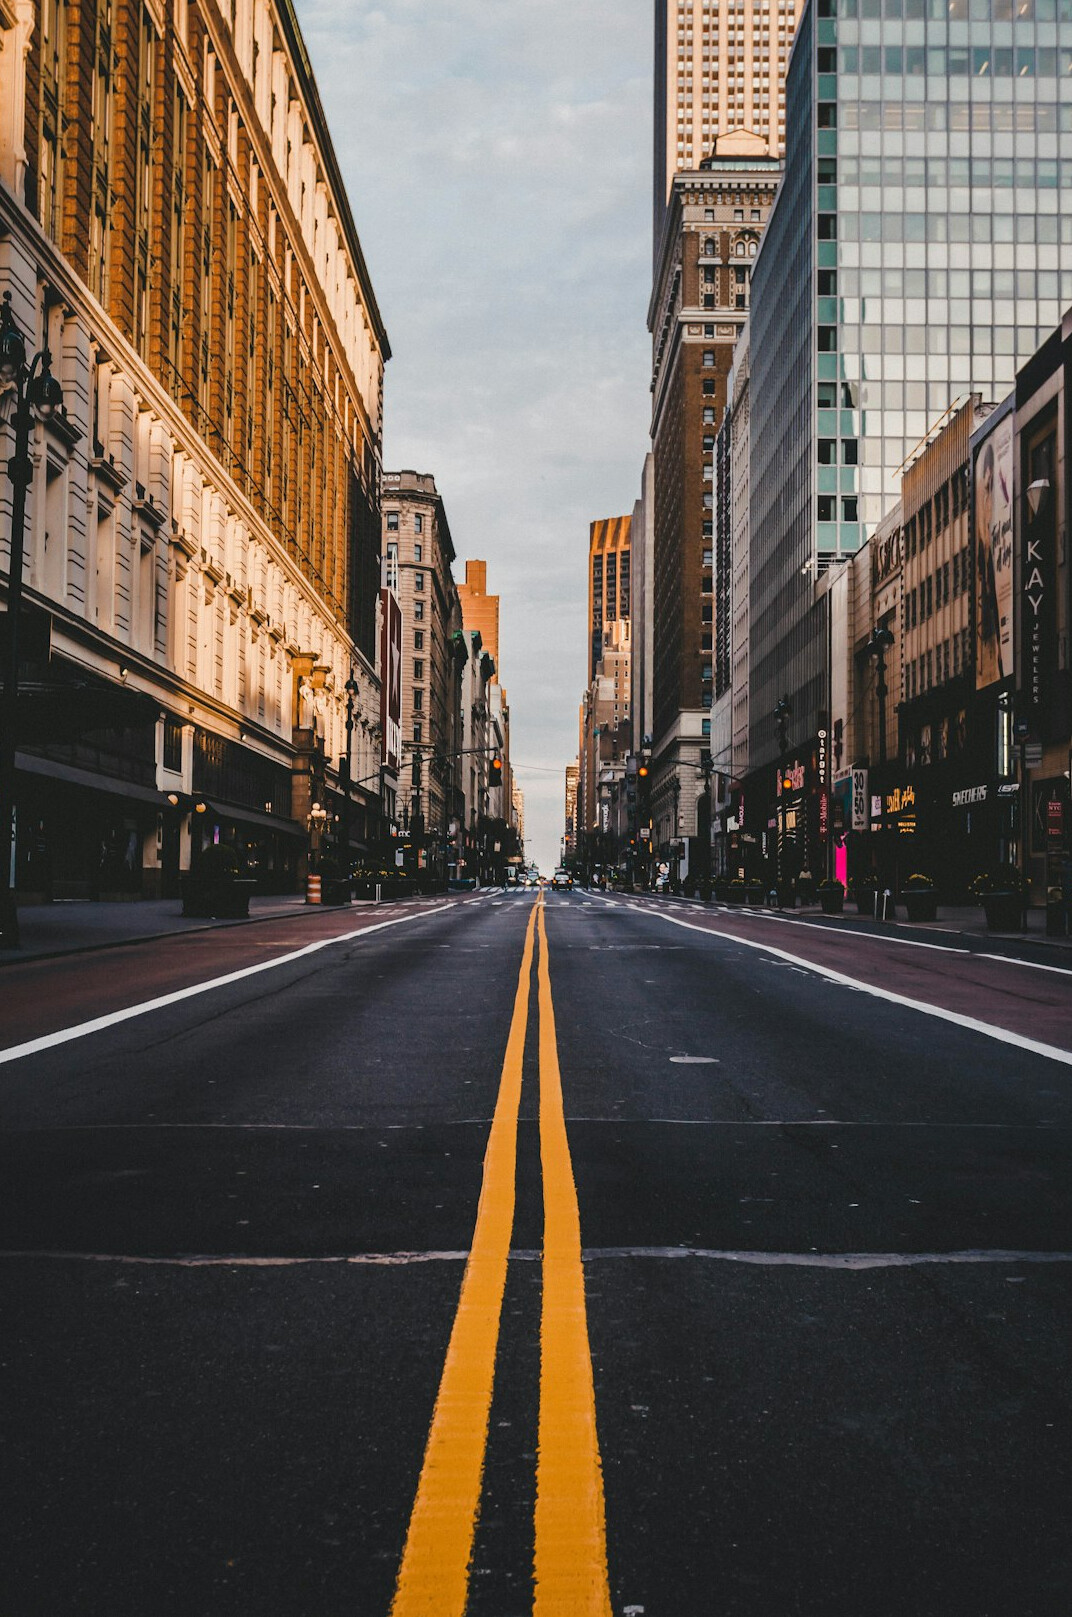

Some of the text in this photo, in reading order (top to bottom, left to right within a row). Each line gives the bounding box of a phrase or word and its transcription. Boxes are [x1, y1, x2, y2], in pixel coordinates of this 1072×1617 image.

[1027, 540, 1043, 616] KAY
[1032, 622, 1040, 704] JEWELERS
[818, 738, 826, 784] target
[854, 772, 865, 791] 30
[952, 784, 988, 807] SKECHERS
[854, 797, 865, 815] 50
